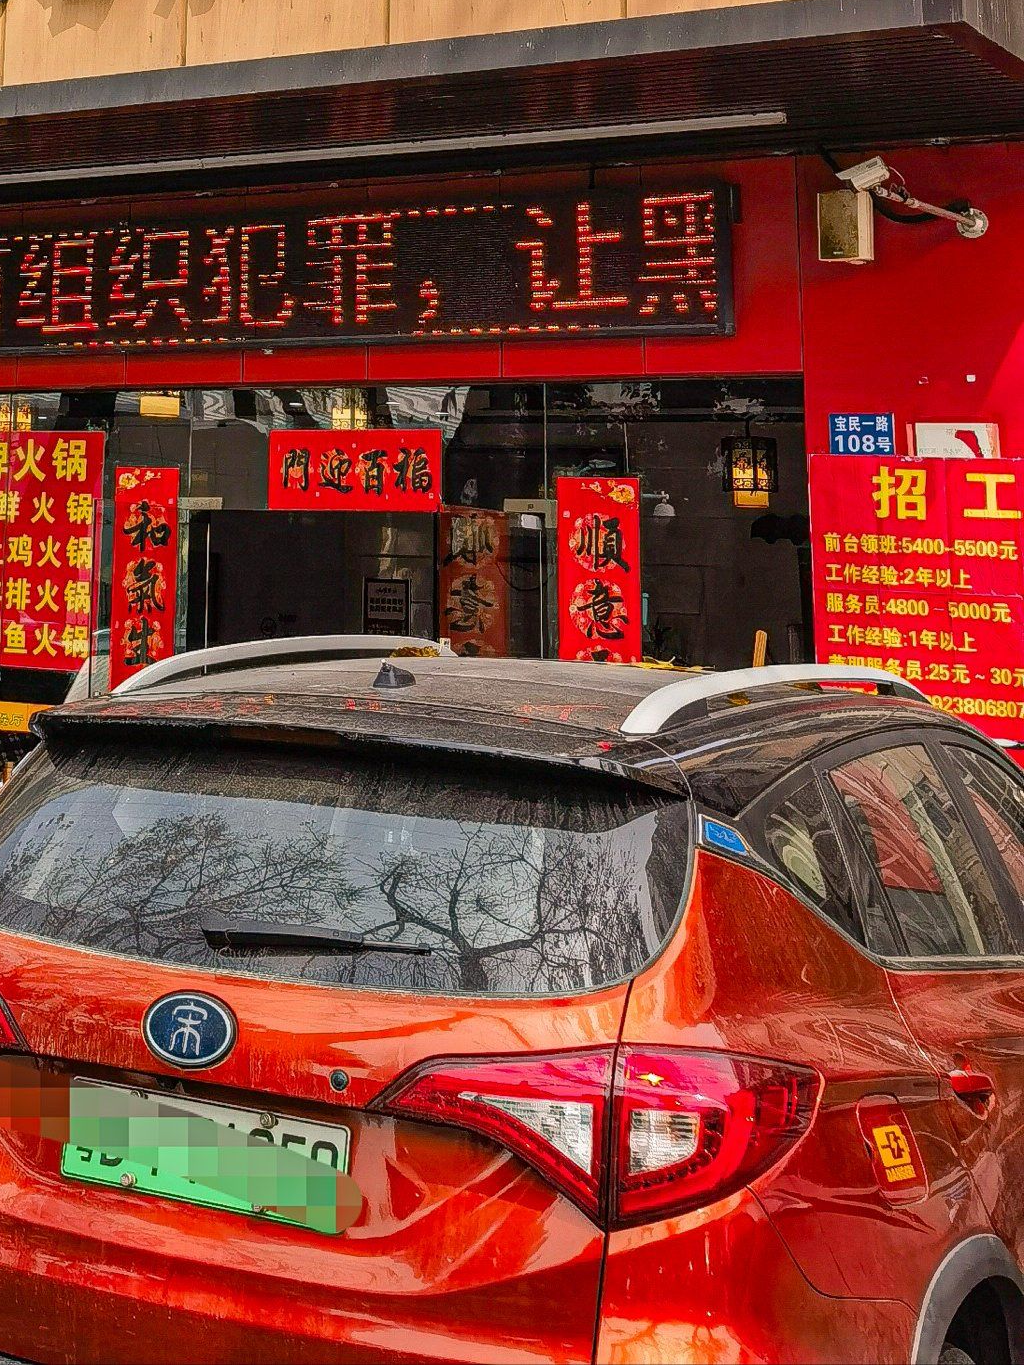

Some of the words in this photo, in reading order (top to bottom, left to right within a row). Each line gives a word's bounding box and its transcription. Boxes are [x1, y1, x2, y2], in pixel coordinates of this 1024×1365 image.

[834, 416, 889, 432] 宝民一路
[834, 435, 892, 453] 108号
[575, 514, 630, 661] 順意
